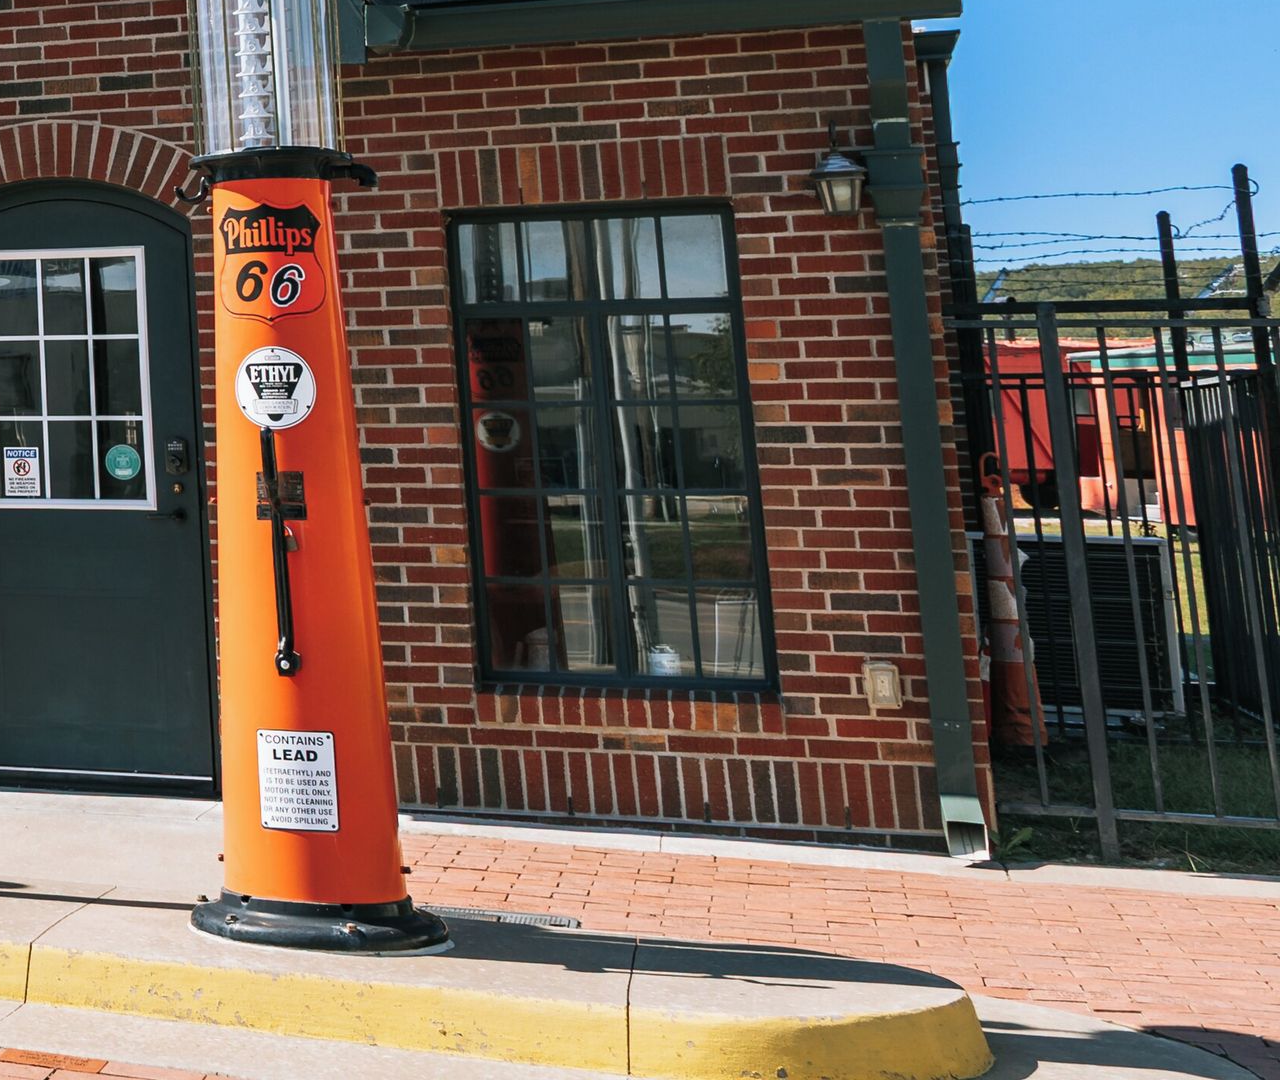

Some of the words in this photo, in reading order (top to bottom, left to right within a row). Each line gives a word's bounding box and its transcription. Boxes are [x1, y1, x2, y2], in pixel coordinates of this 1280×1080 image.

[223, 216, 312, 256] Phillips
[236, 260, 306, 308] 66
[249, 365, 299, 383] ETHYL
[7, 450, 35, 458] NOTICE
[265, 734, 324, 746] CONTAINS
[273, 748, 318, 762] LEAD
[264, 786, 289, 794] MOTOR
[296, 798, 333, 806] CLEANING
[292, 807, 316, 815] OTHER
[271, 815, 292, 823] AVOID
[294, 817, 328, 825] SPILLING
